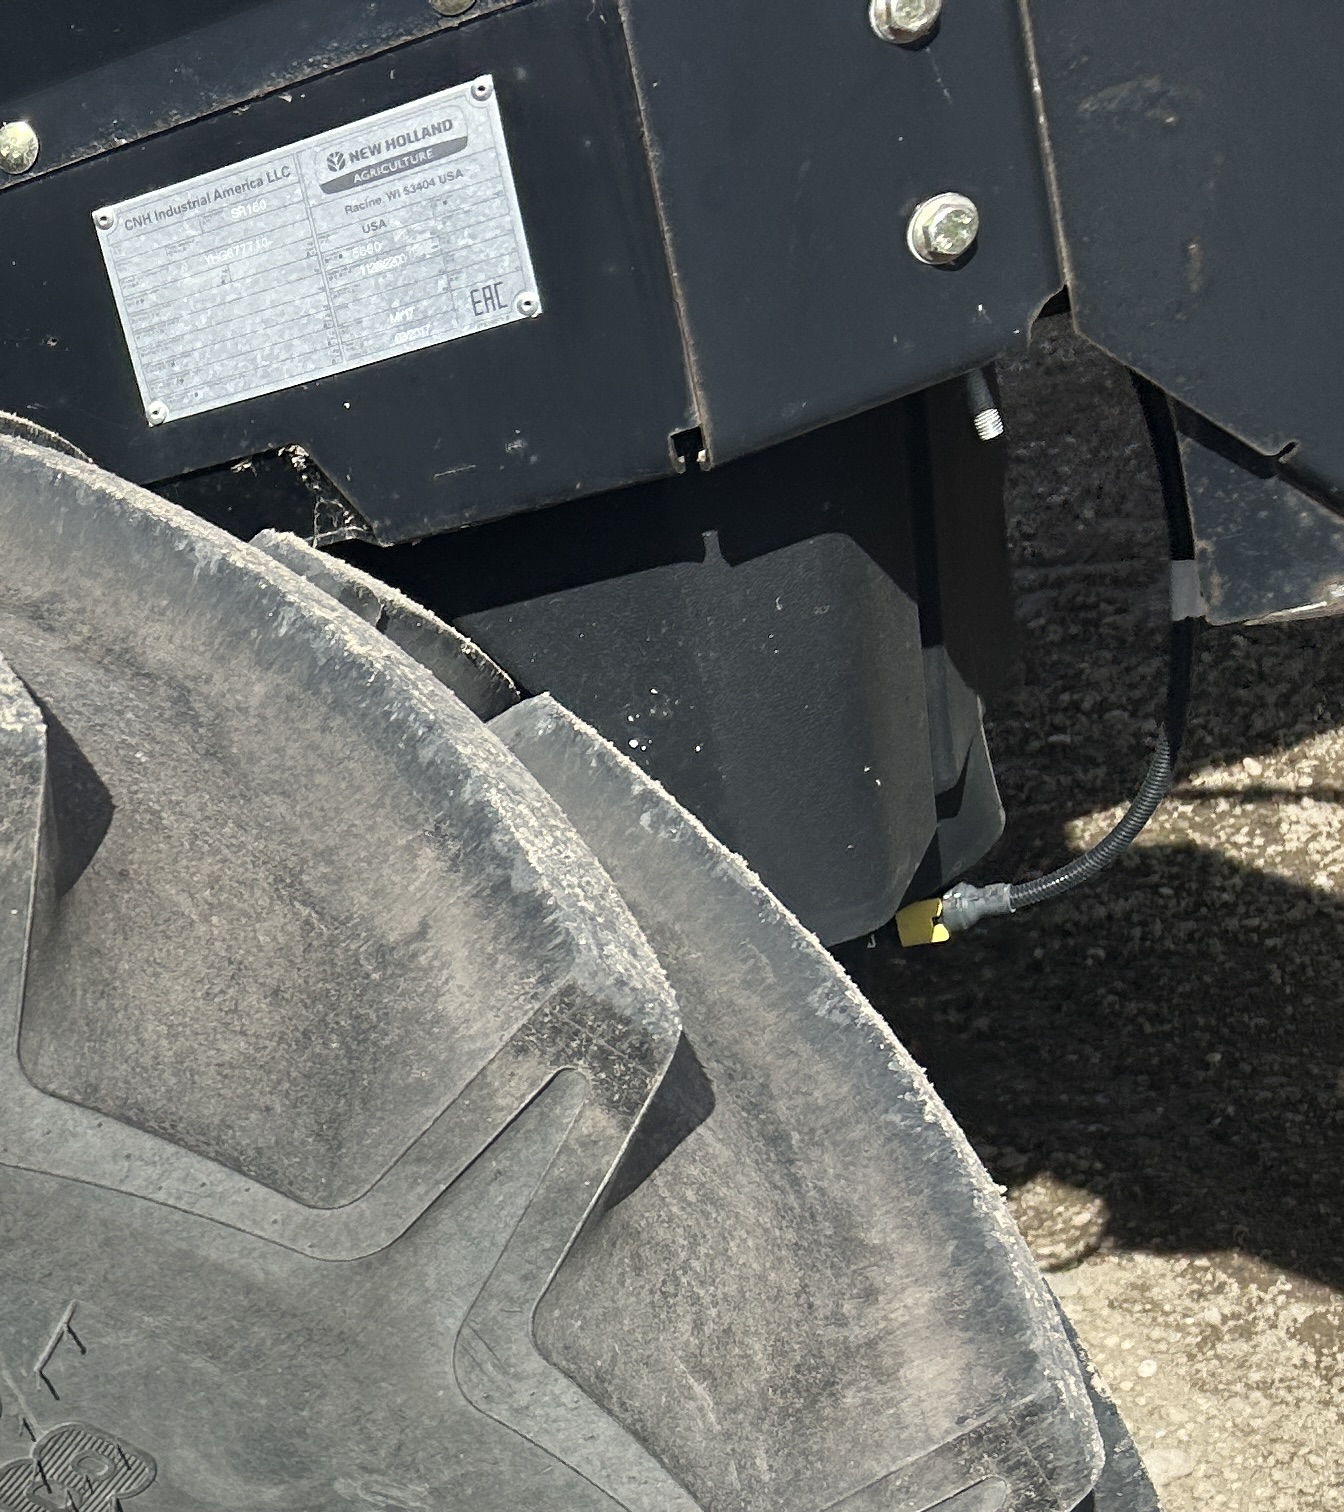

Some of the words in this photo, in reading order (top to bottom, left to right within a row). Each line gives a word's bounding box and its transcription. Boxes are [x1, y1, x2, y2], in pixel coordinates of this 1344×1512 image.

[348, 142, 382, 165] NEW
[385, 118, 454, 152] HOLLAND
[352, 148, 436, 184] AGRICULTURE
[124, 212, 152, 231] CNH
[155, 192, 212, 222] Industrial
[213, 175, 264, 201] America
[266, 165, 292, 184] LLC
[385, 188, 402, 202] WI
[438, 168, 465, 185] USA
[361, 218, 388, 235] USA
[469, 280, 509, 317] EAC
